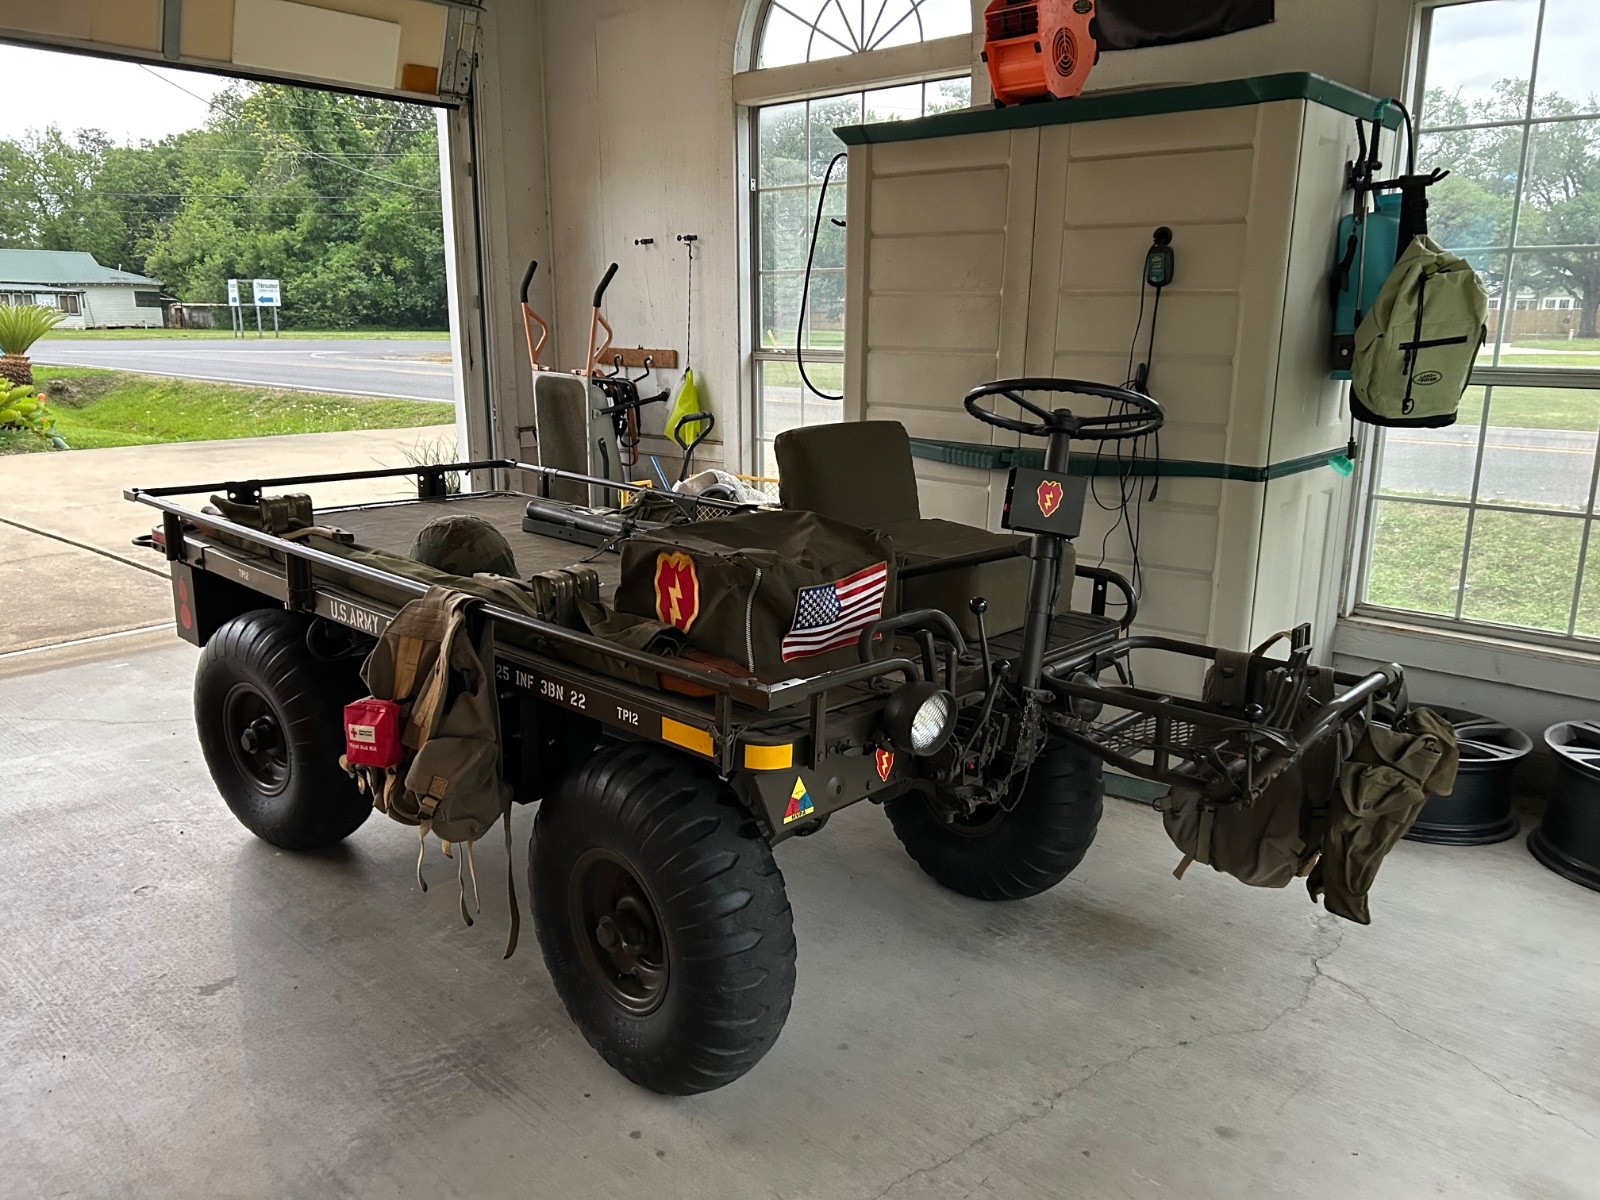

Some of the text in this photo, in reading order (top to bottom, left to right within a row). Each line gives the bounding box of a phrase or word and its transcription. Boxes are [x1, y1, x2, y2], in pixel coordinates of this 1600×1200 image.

[496, 664, 586, 709] 25 INF 3BN 22
